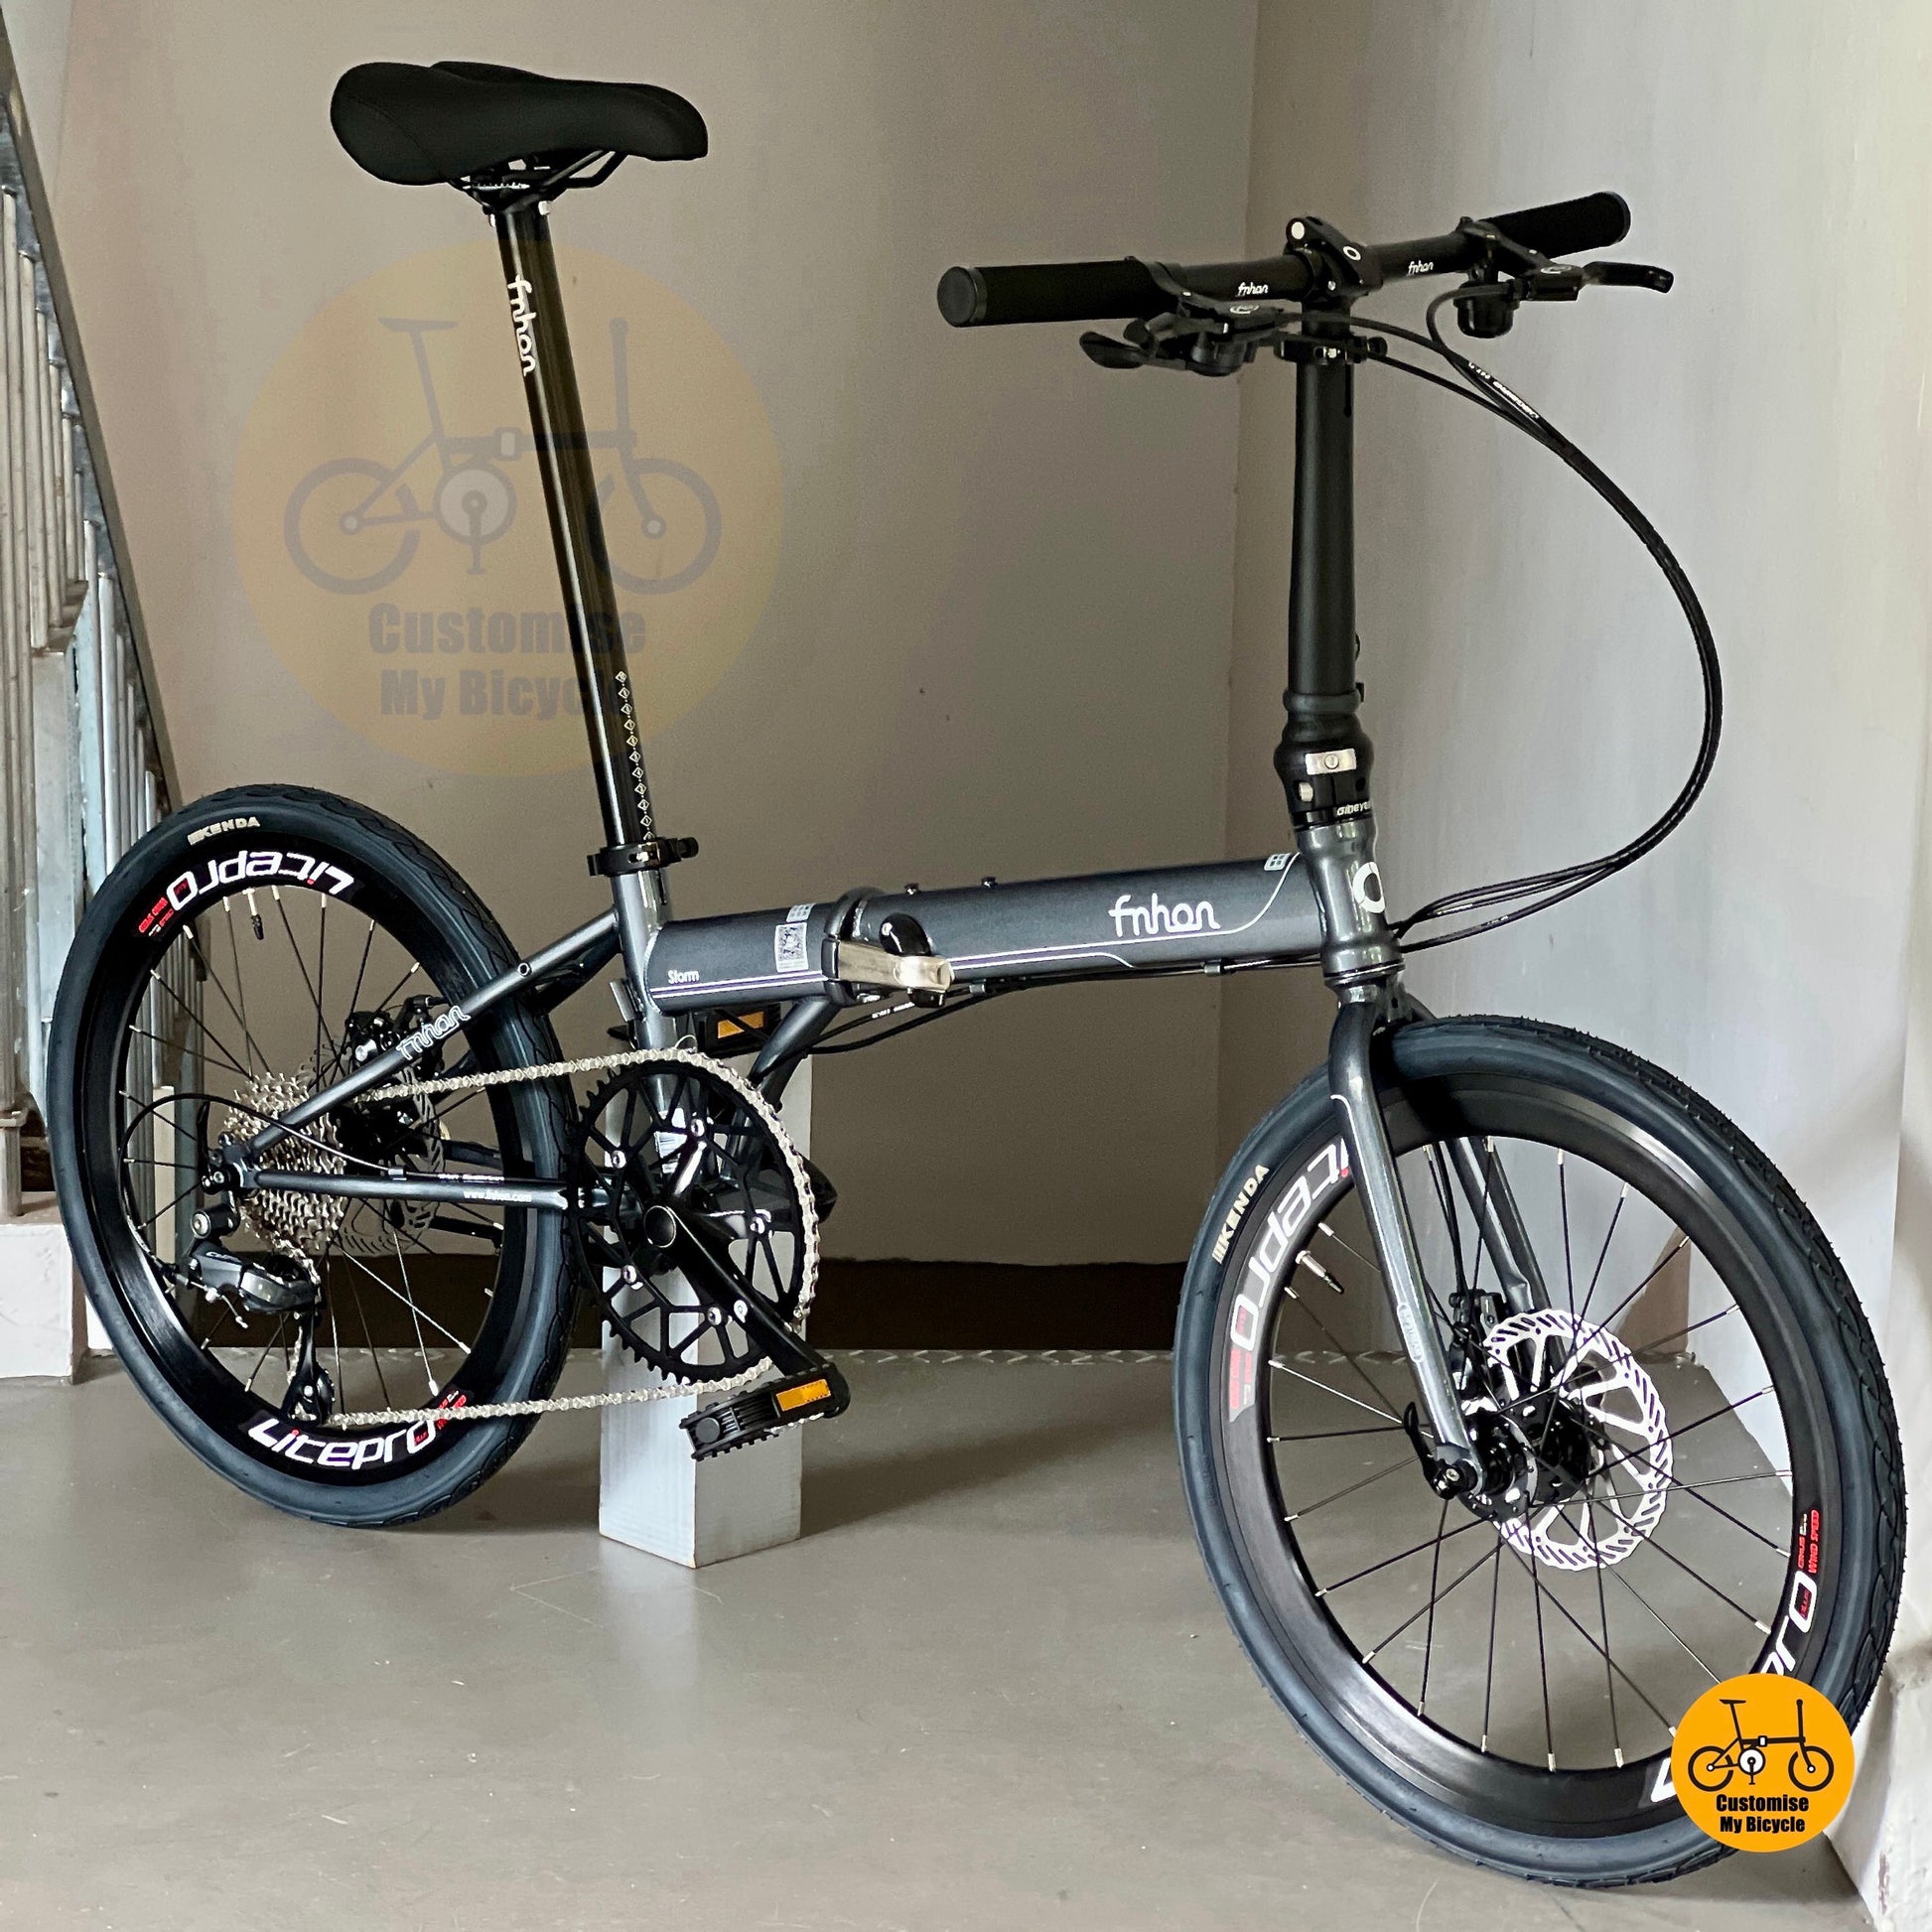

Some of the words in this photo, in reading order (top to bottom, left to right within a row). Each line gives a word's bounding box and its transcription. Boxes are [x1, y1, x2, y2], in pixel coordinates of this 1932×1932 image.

[200, 816, 260, 840] KENDA
[1108, 893, 1220, 937] fnhon
[667, 969, 699, 984] Storm
[1219, 1164, 1270, 1245] KENDA
[1230, 1136, 1349, 1350] itepro
